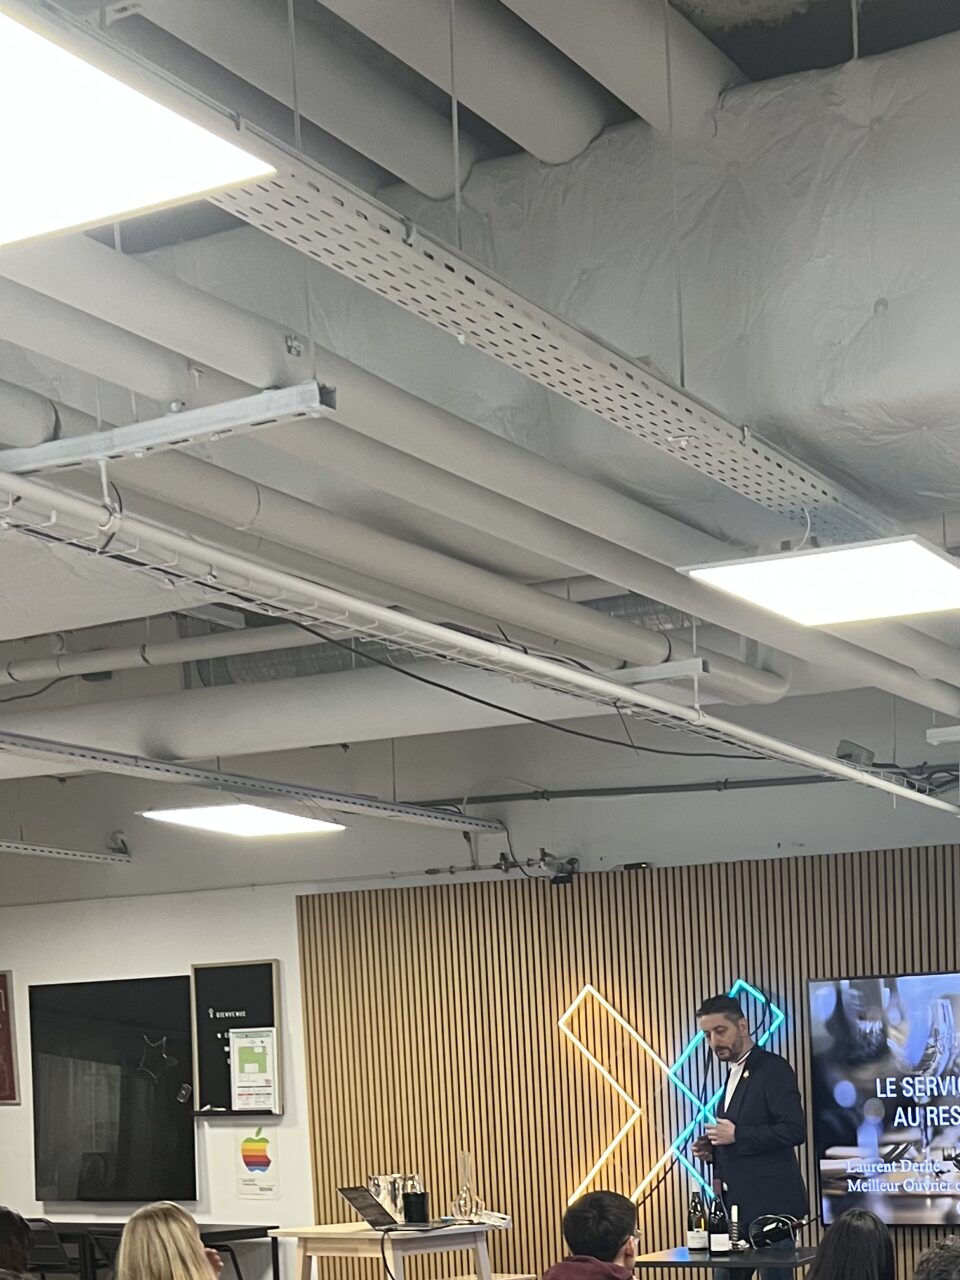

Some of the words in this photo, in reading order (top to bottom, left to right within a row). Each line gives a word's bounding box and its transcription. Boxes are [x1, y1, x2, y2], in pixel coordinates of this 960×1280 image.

[875, 1077, 897, 1098] LE
[893, 1105, 920, 1127] AU
[846, 1160, 897, 1173] Laurent
[847, 1178, 901, 1192] Meilleur
[903, 1178, 952, 1192] Ouvrier
